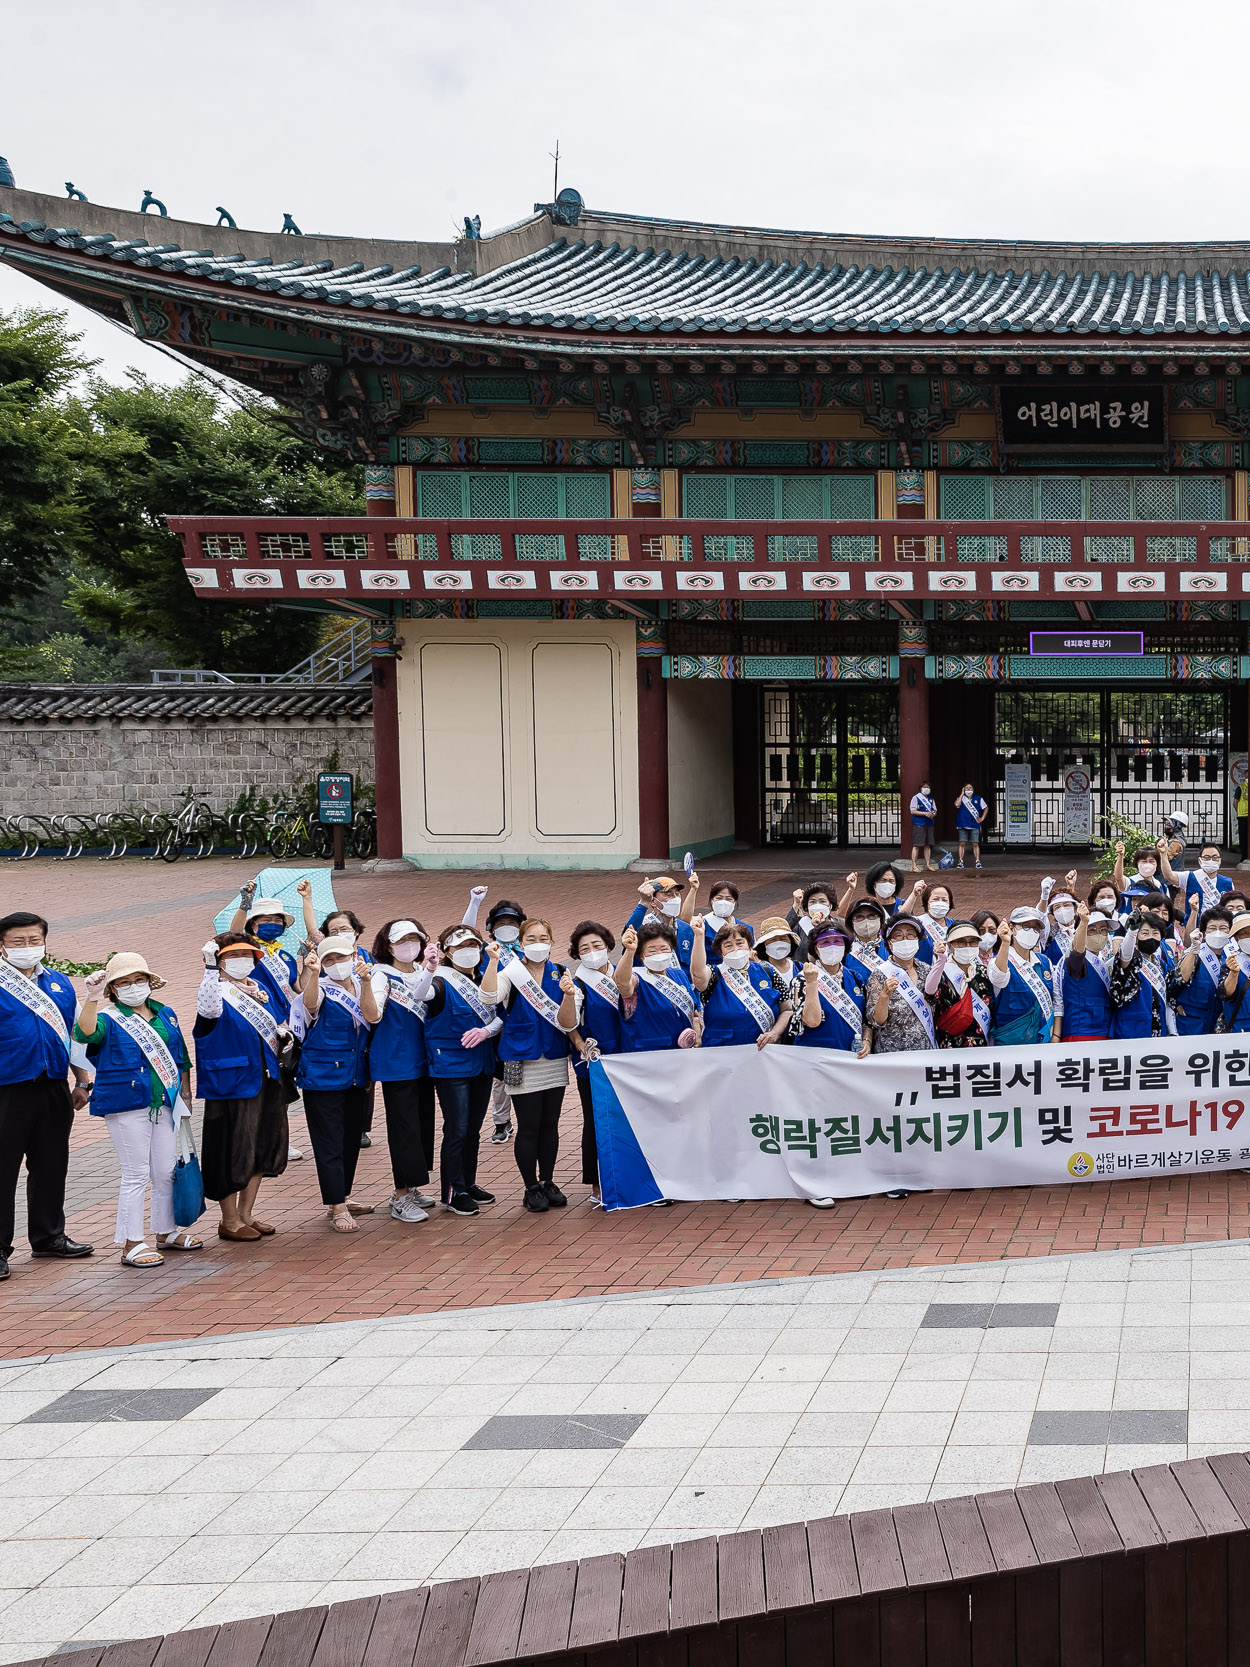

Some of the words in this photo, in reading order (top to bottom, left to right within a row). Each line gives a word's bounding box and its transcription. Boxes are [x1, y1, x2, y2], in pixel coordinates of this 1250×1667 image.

[1017, 401, 1150, 429] 어린이대공원
[1064, 639, 1091, 648] 대피후엔
[1092, 639, 1112, 648] 문닫기
[1056, 1053, 1174, 1094] 확립을
[749, 1106, 1024, 1159] 행락질서지키기
[1038, 1105, 1074, 1144] 및
[1086, 1098, 1245, 1140] 코로나19
[1096, 1152, 1115, 1164] 사단
[1096, 1163, 1115, 1175] 법인
[1117, 1148, 1232, 1170] 바르게살기운동
